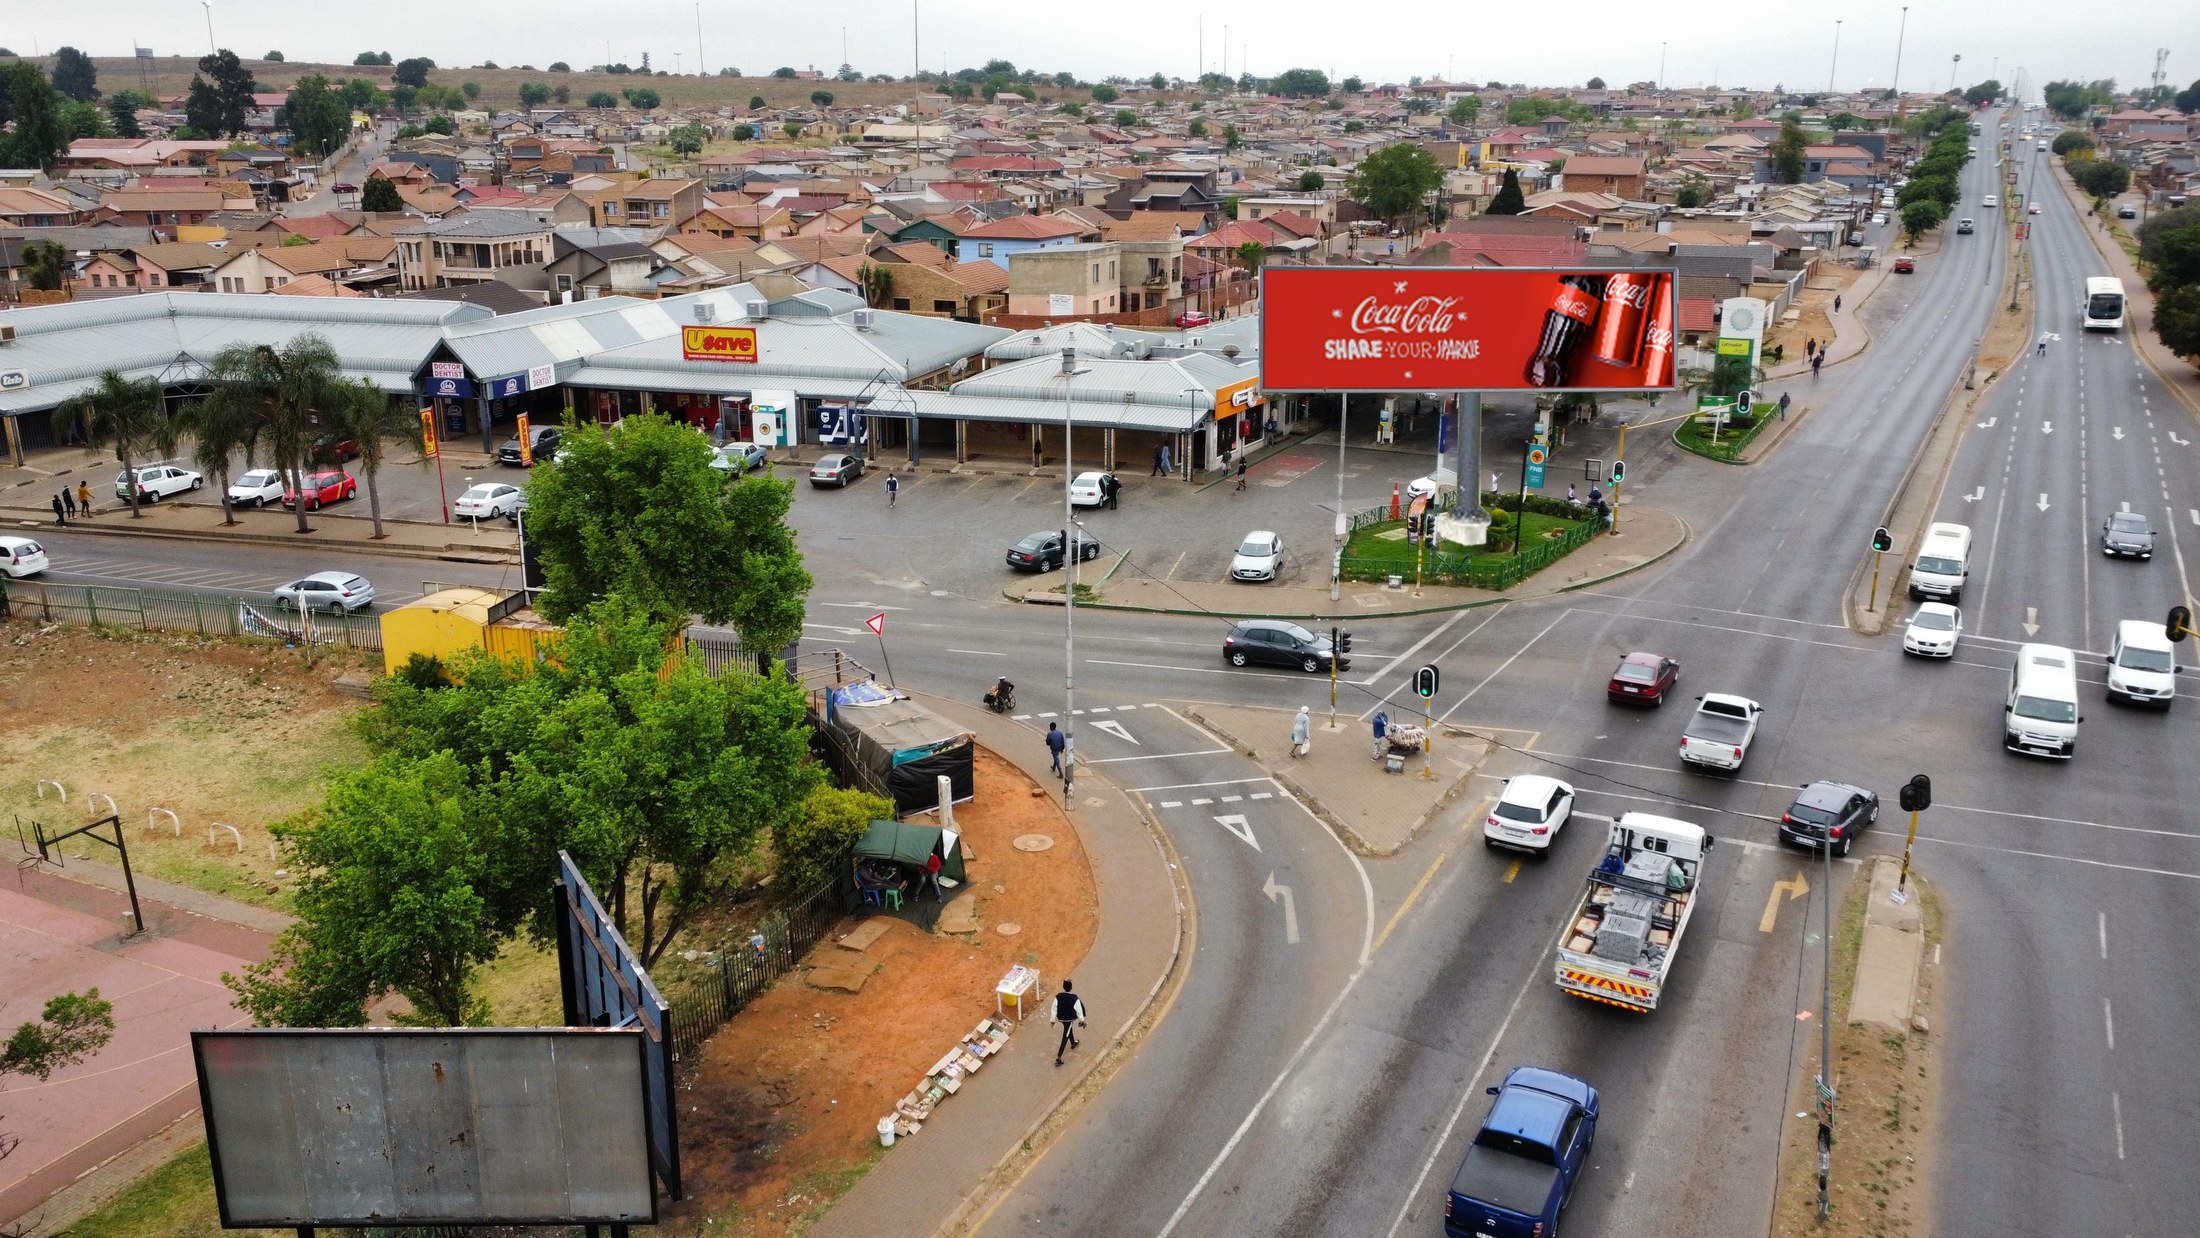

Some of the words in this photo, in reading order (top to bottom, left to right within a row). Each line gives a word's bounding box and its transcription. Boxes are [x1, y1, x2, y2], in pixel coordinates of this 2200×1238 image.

[1351, 296, 1459, 334] Coca-Cola
[1325, 338, 1382, 360] SHARE
[1387, 341, 1432, 358] YOUR
[532, 366, 551, 378] DOCTOR
[533, 376, 551, 387] DENTIST
